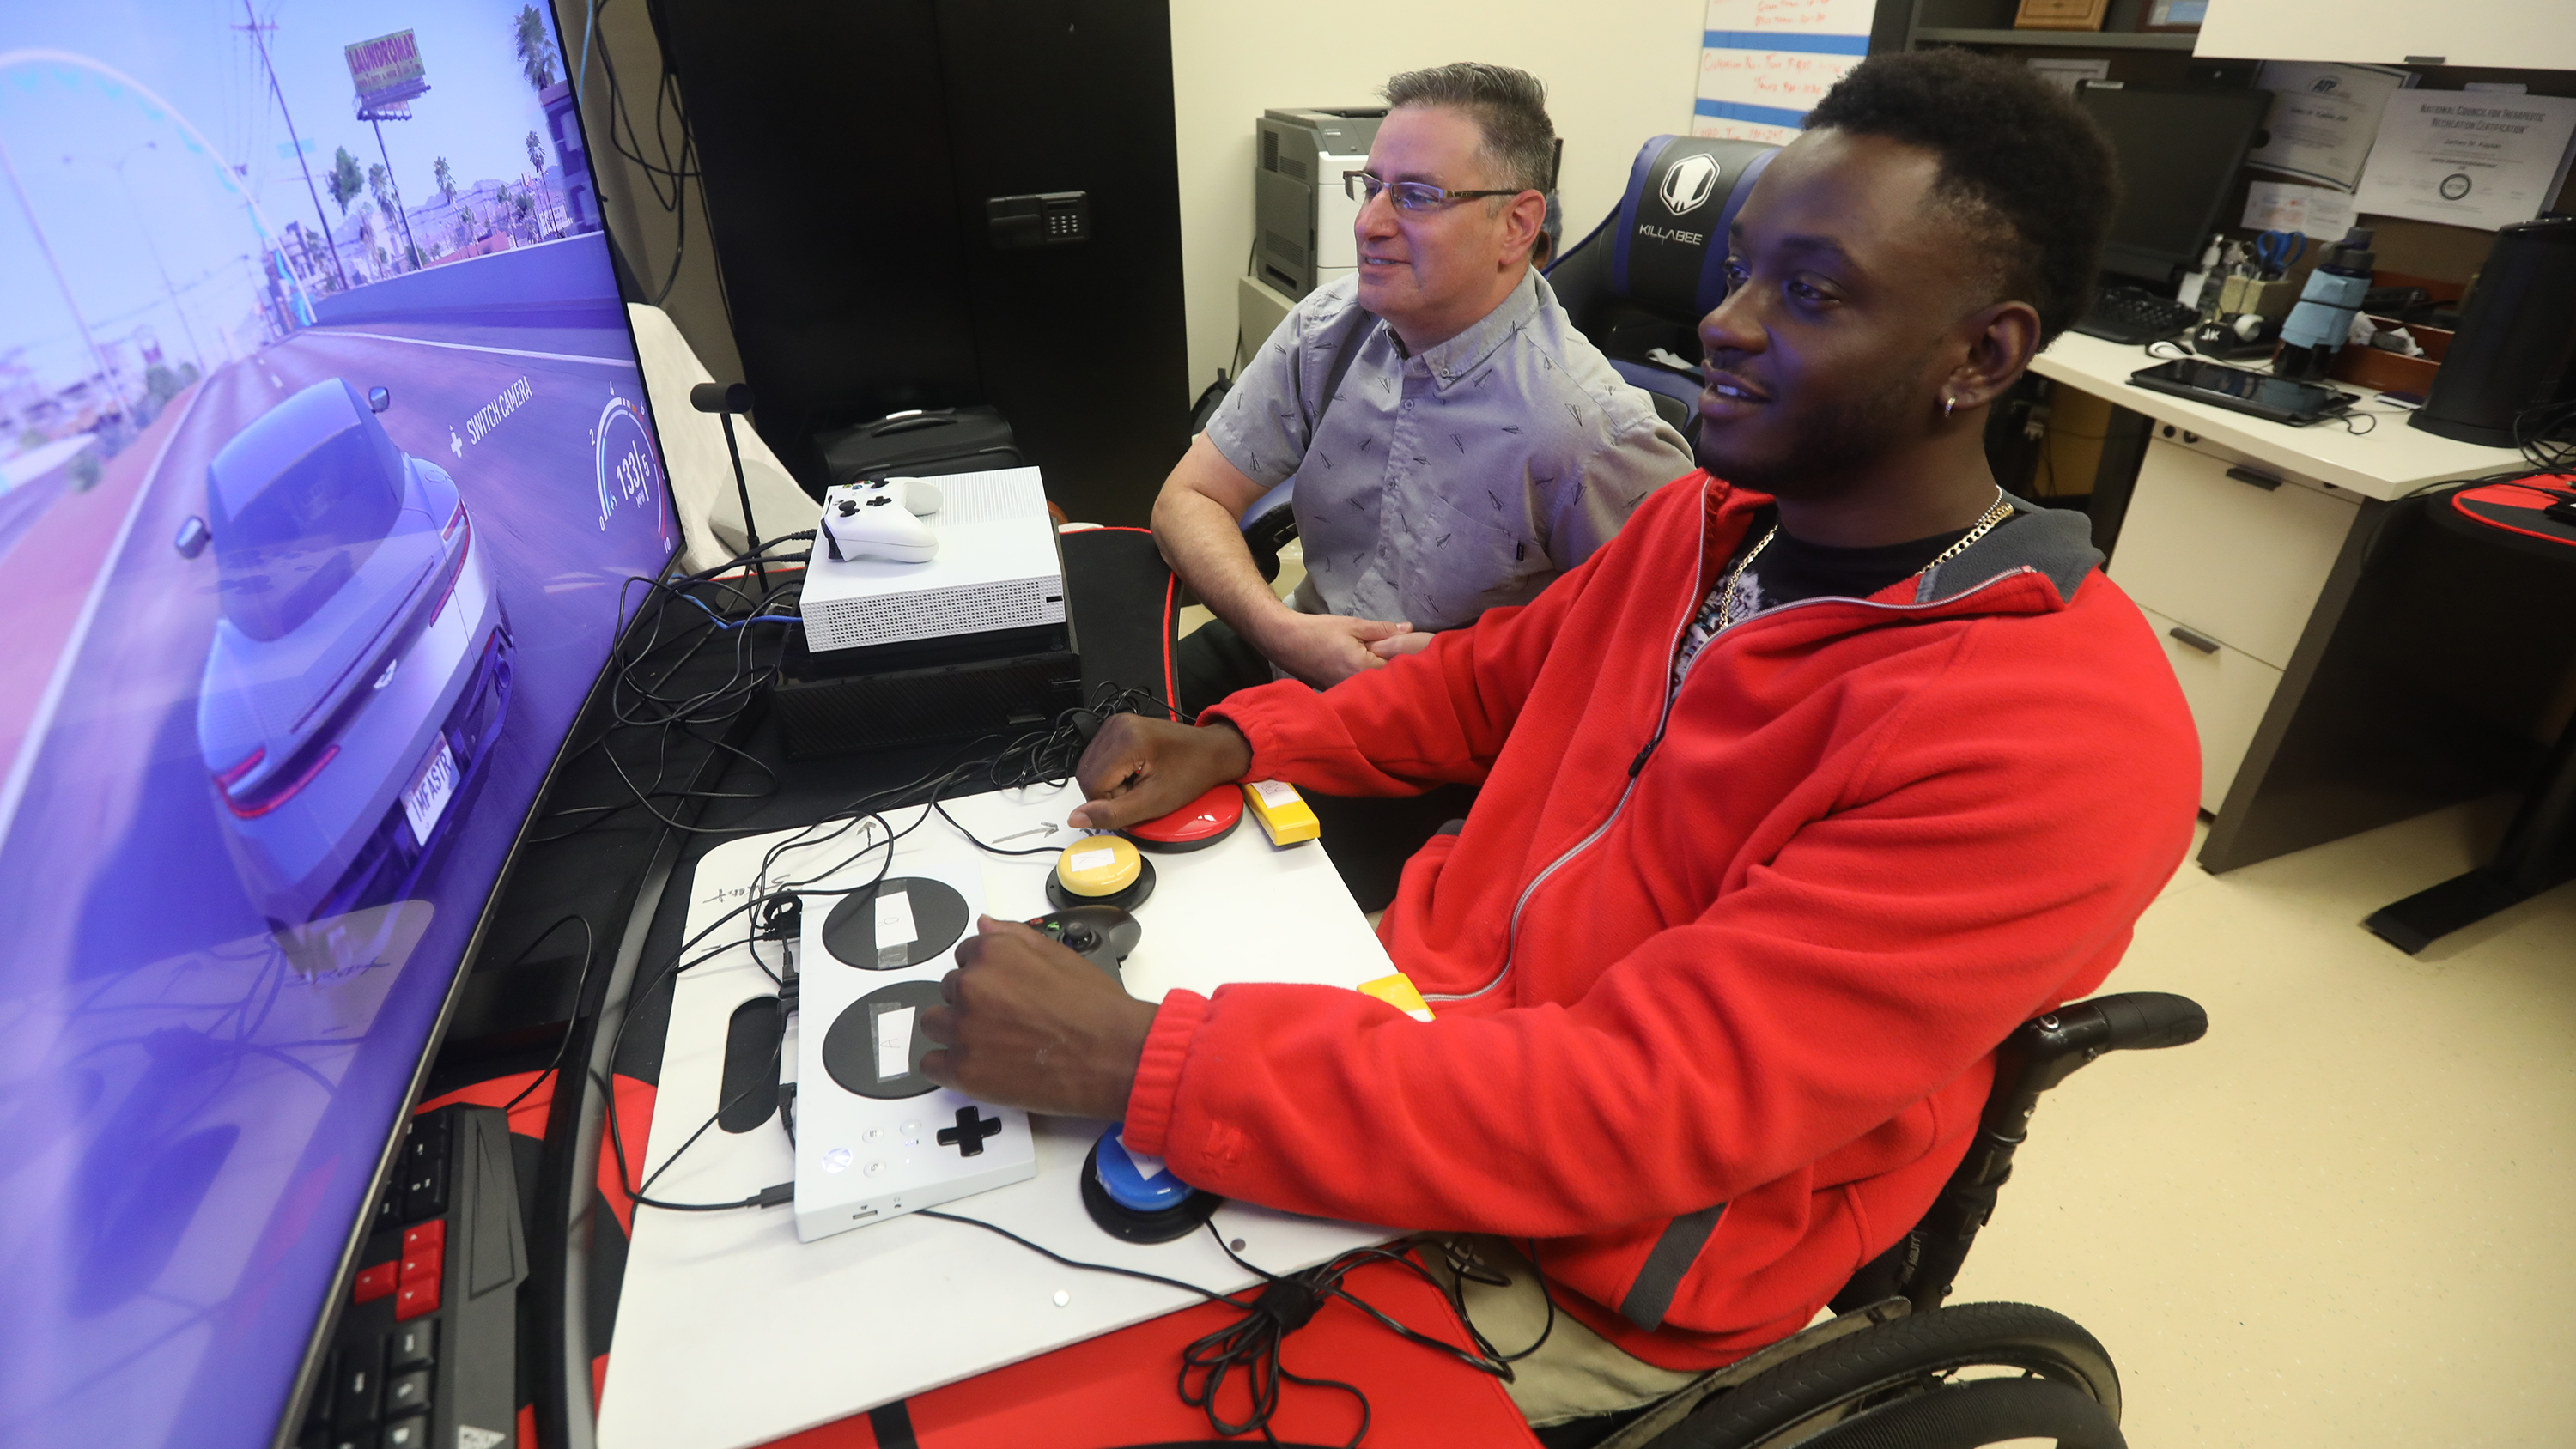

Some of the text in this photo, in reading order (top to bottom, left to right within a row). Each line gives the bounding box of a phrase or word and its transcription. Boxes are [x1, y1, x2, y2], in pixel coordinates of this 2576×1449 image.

[348, 33, 417, 76] LAUNDROMAT
[1639, 224, 1704, 245] KILLABEE
[466, 375, 533, 445] SWITCH CAMERA
[589, 428, 595, 446] 2
[877, 917, 900, 928] B
[880, 1038, 901, 1049] A
